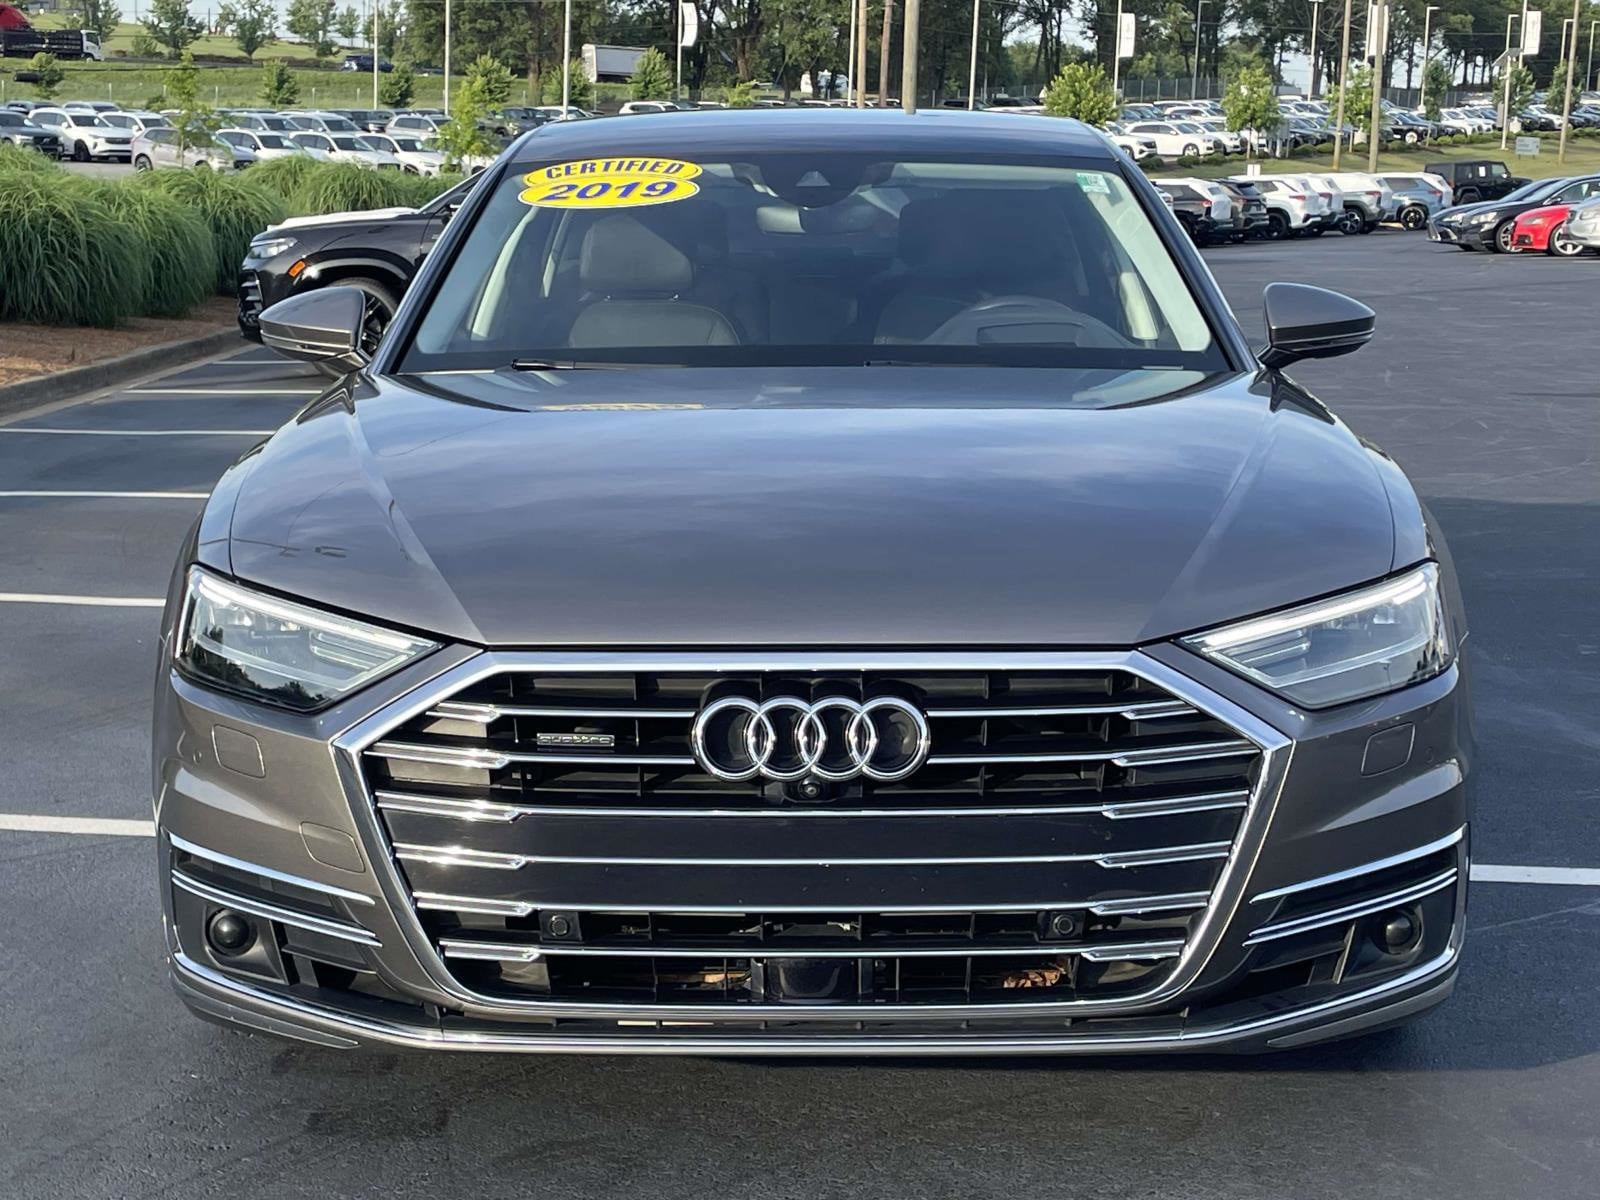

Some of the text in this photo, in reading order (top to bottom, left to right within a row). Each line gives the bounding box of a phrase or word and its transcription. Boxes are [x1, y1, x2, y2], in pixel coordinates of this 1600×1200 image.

[546, 160, 684, 179] CERTIFIED
[538, 181, 677, 202] 2019
[539, 735, 611, 744] quattro
